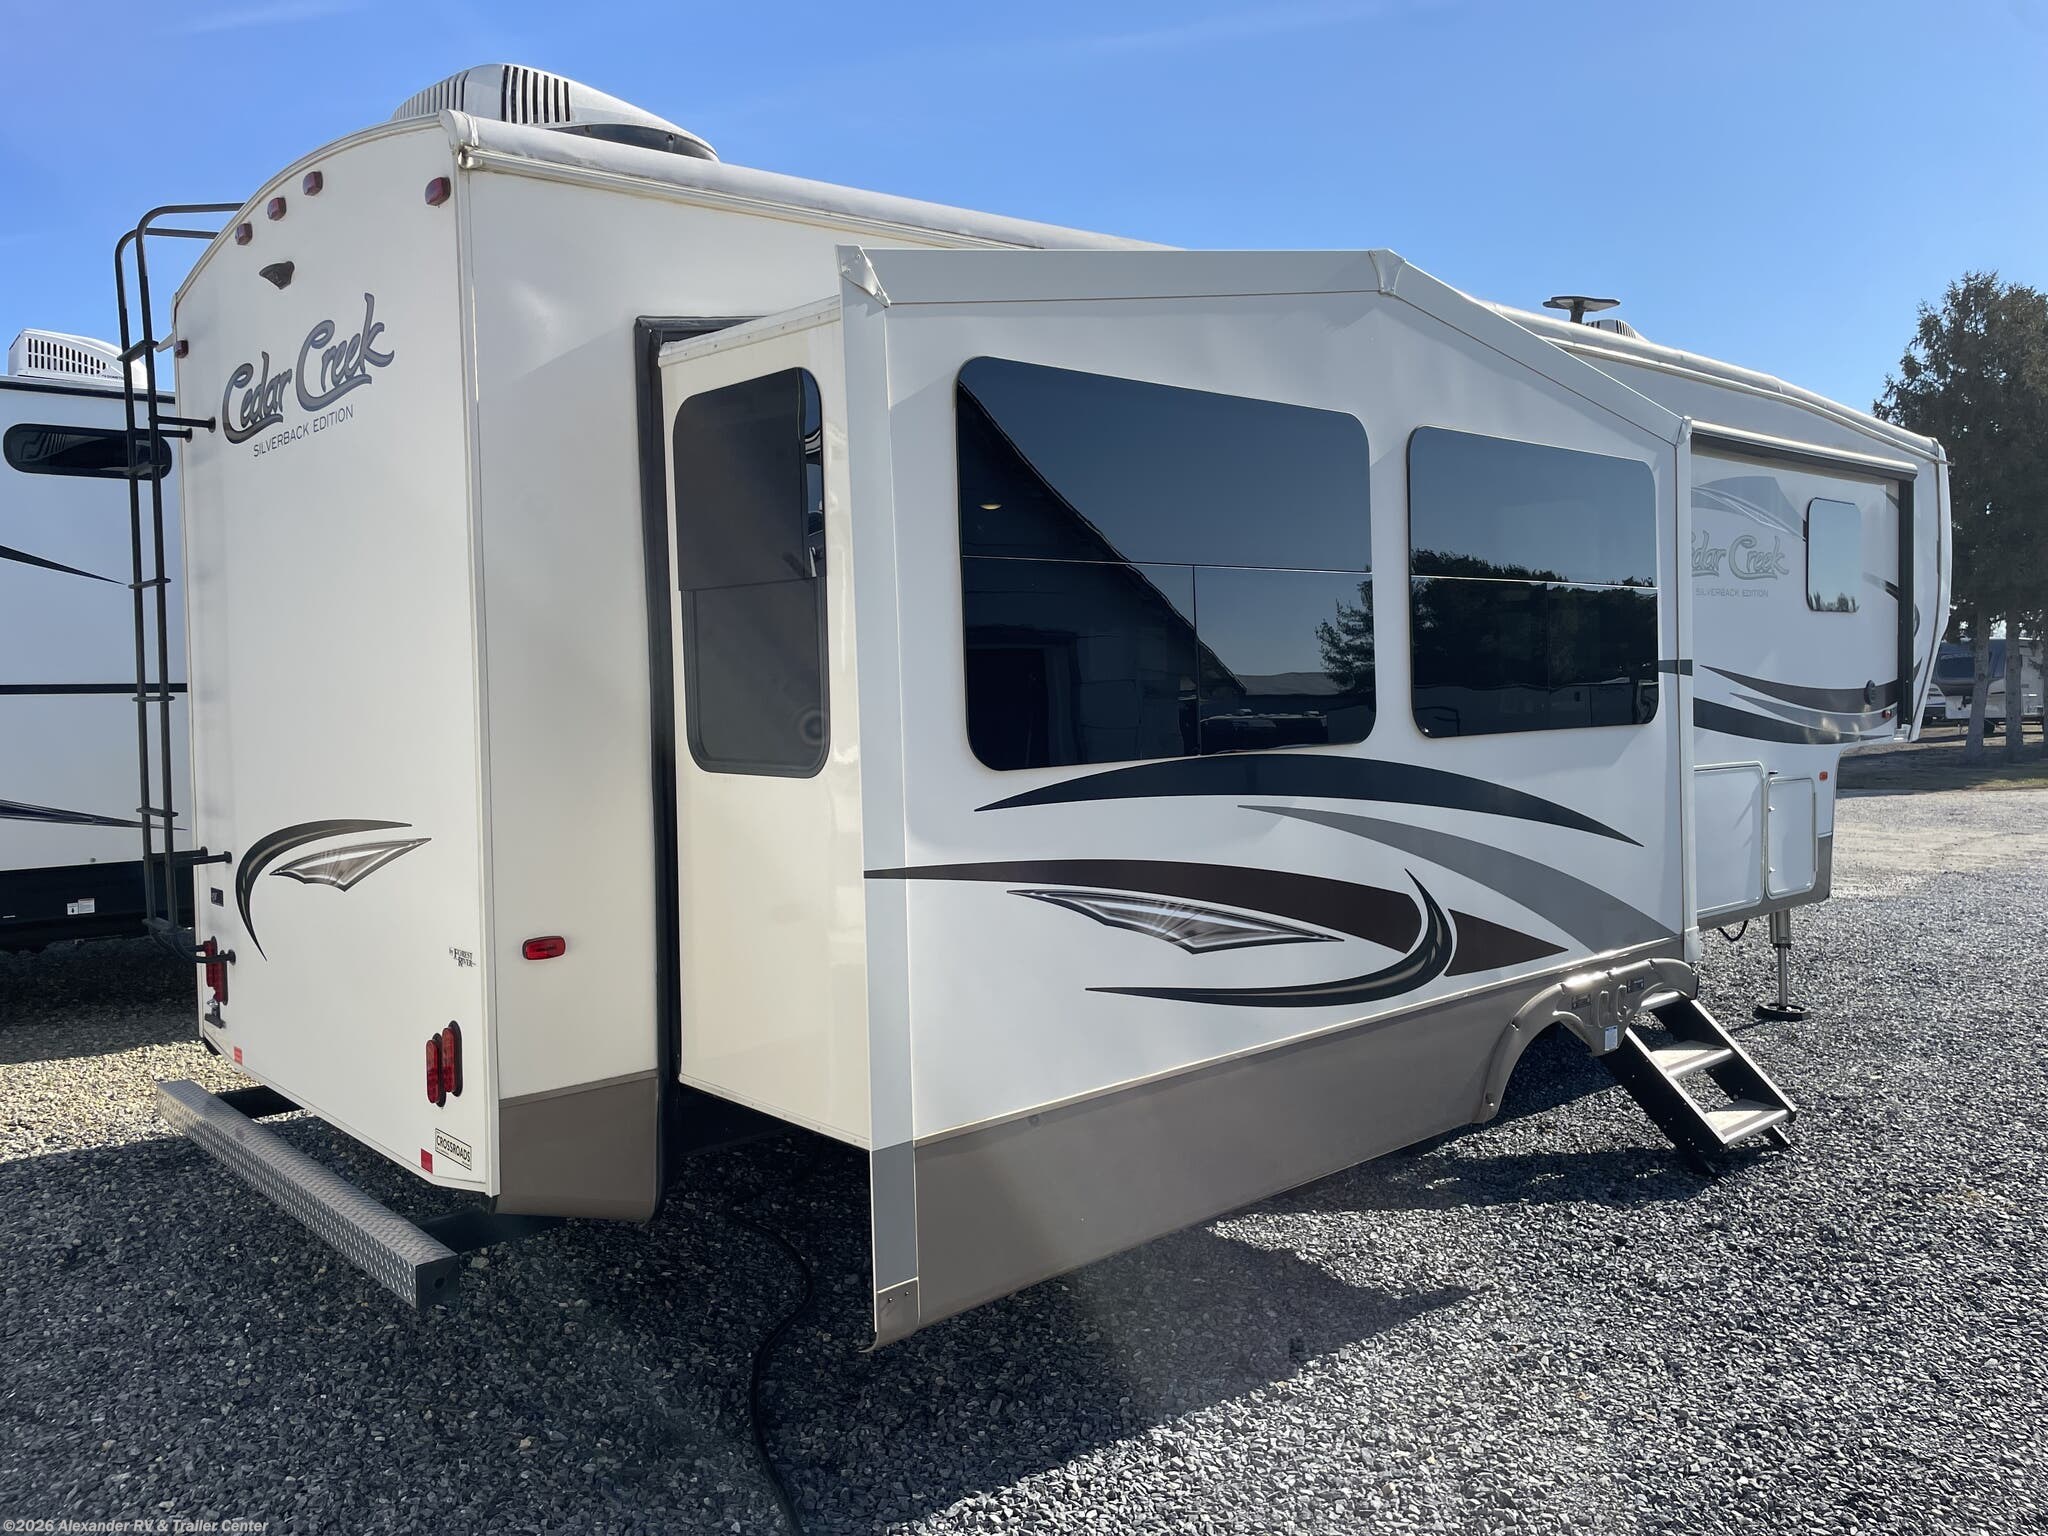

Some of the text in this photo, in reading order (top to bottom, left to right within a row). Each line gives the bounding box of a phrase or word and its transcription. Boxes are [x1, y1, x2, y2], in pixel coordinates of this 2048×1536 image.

[222, 292, 395, 444] Cedar Creek
[253, 404, 354, 457] SILVERBACK EDITION
[1728, 534, 1789, 580] Creek
[1742, 587, 1769, 598] EDITION
[436, 1134, 471, 1162] CROSSROADS
